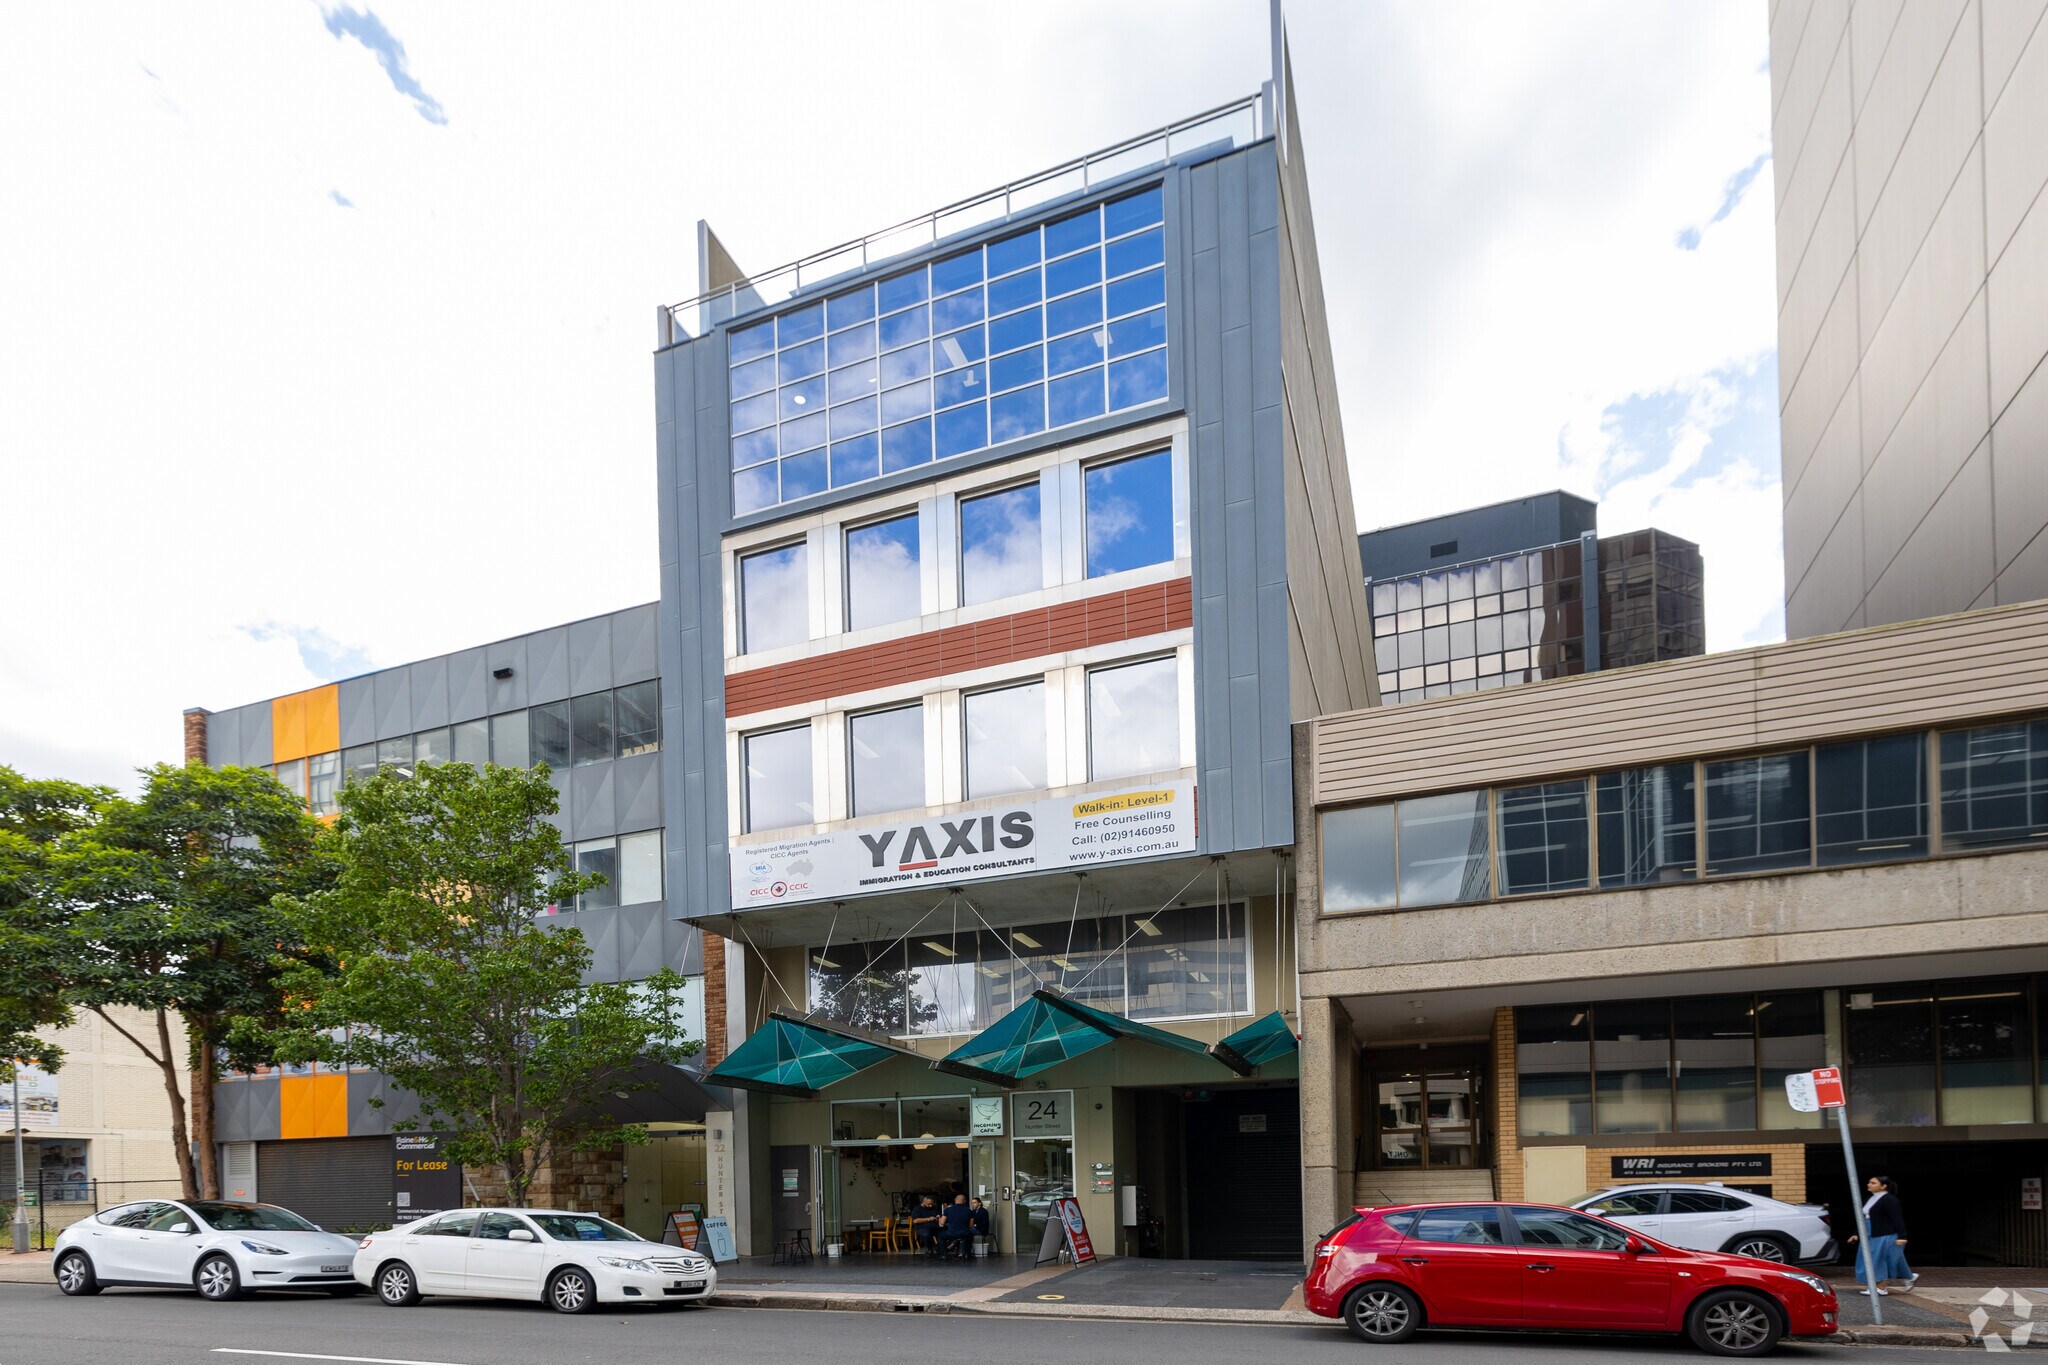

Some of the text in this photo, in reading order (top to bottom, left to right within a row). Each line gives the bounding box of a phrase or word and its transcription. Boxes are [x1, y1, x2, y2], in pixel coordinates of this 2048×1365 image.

[1078, 793, 1168, 814] Walk-in: Level-1
[1075, 810, 1171, 830] Free Counselling
[858, 811, 1034, 868] YAXIS
[1072, 824, 1175, 845] Call: (02)91460950
[746, 838, 830, 855] Registered Migration Agents
[787, 849, 808, 857] Agents
[1069, 840, 1179, 860] www.y-axis.com.au
[860, 872, 913, 885] IMMIGRATION
[924, 865, 971, 878] EDUCATION
[973, 857, 1035, 871] CONSULTANTS
[1028, 1100, 1058, 1120] 24
[715, 1144, 725, 1152] 22
[396, 1160, 448, 1170] For Lease
[1623, 1159, 1655, 1169] WRI
[718, 1201, 723, 1214] ST
